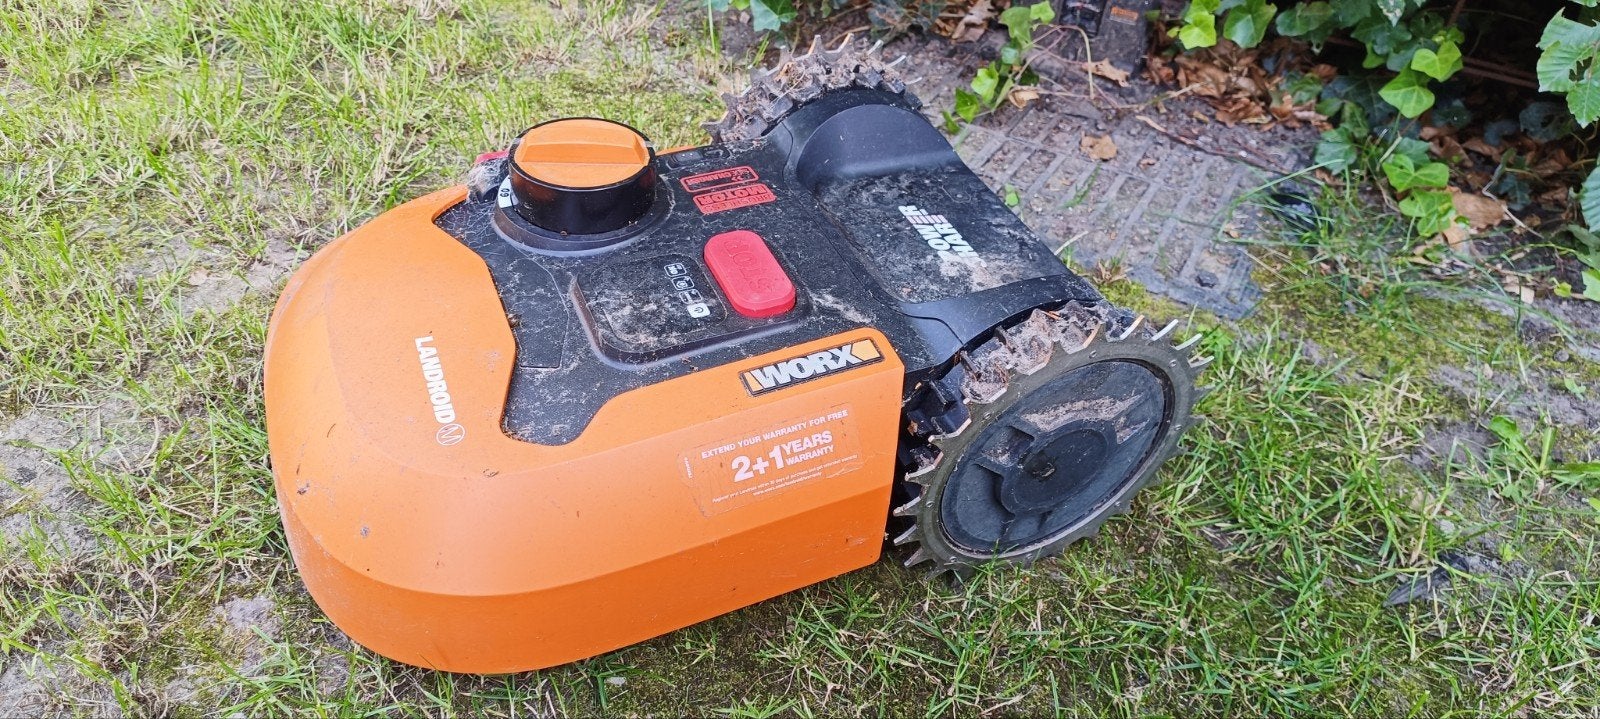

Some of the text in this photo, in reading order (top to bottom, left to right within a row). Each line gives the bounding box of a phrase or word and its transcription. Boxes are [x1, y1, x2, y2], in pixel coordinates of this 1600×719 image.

[697, 187, 767, 205] MOTOR
[415, 336, 456, 424] LANDROID
[750, 344, 862, 389] WORX
[701, 409, 848, 459] EXTEND YOUR WARRANTY FOR FREE
[781, 430, 833, 455] YEARS
[731, 445, 784, 482] 2+1
[785, 444, 834, 466] WARRANTY
